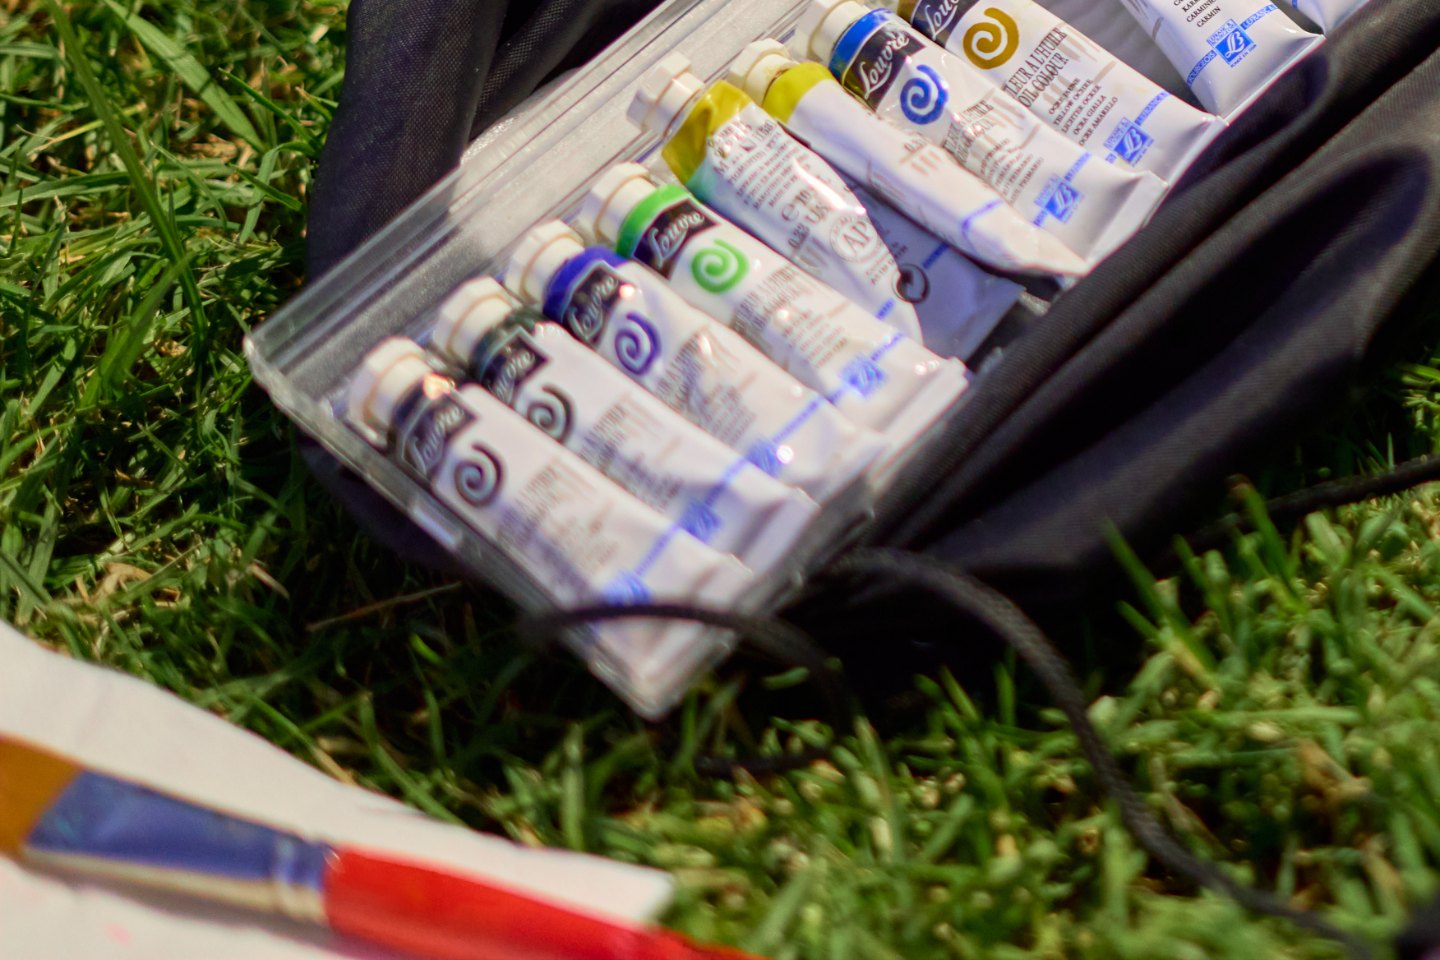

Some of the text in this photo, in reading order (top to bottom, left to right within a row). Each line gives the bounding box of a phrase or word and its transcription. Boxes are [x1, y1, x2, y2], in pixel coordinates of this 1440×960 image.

[1196, 6, 1221, 27] CARMIN
[858, 33, 909, 99] Louvre
[1024, 57, 1039, 72] A
[1029, 26, 1067, 65] L'HUILE
[1017, 51, 1069, 109] OIL COLOUR
[649, 212, 705, 267] Louvre
[841, 219, 875, 253] AP
[570, 274, 618, 340] Louvre
[487, 349, 535, 405] ouvre
[412, 407, 463, 472] Louvre
